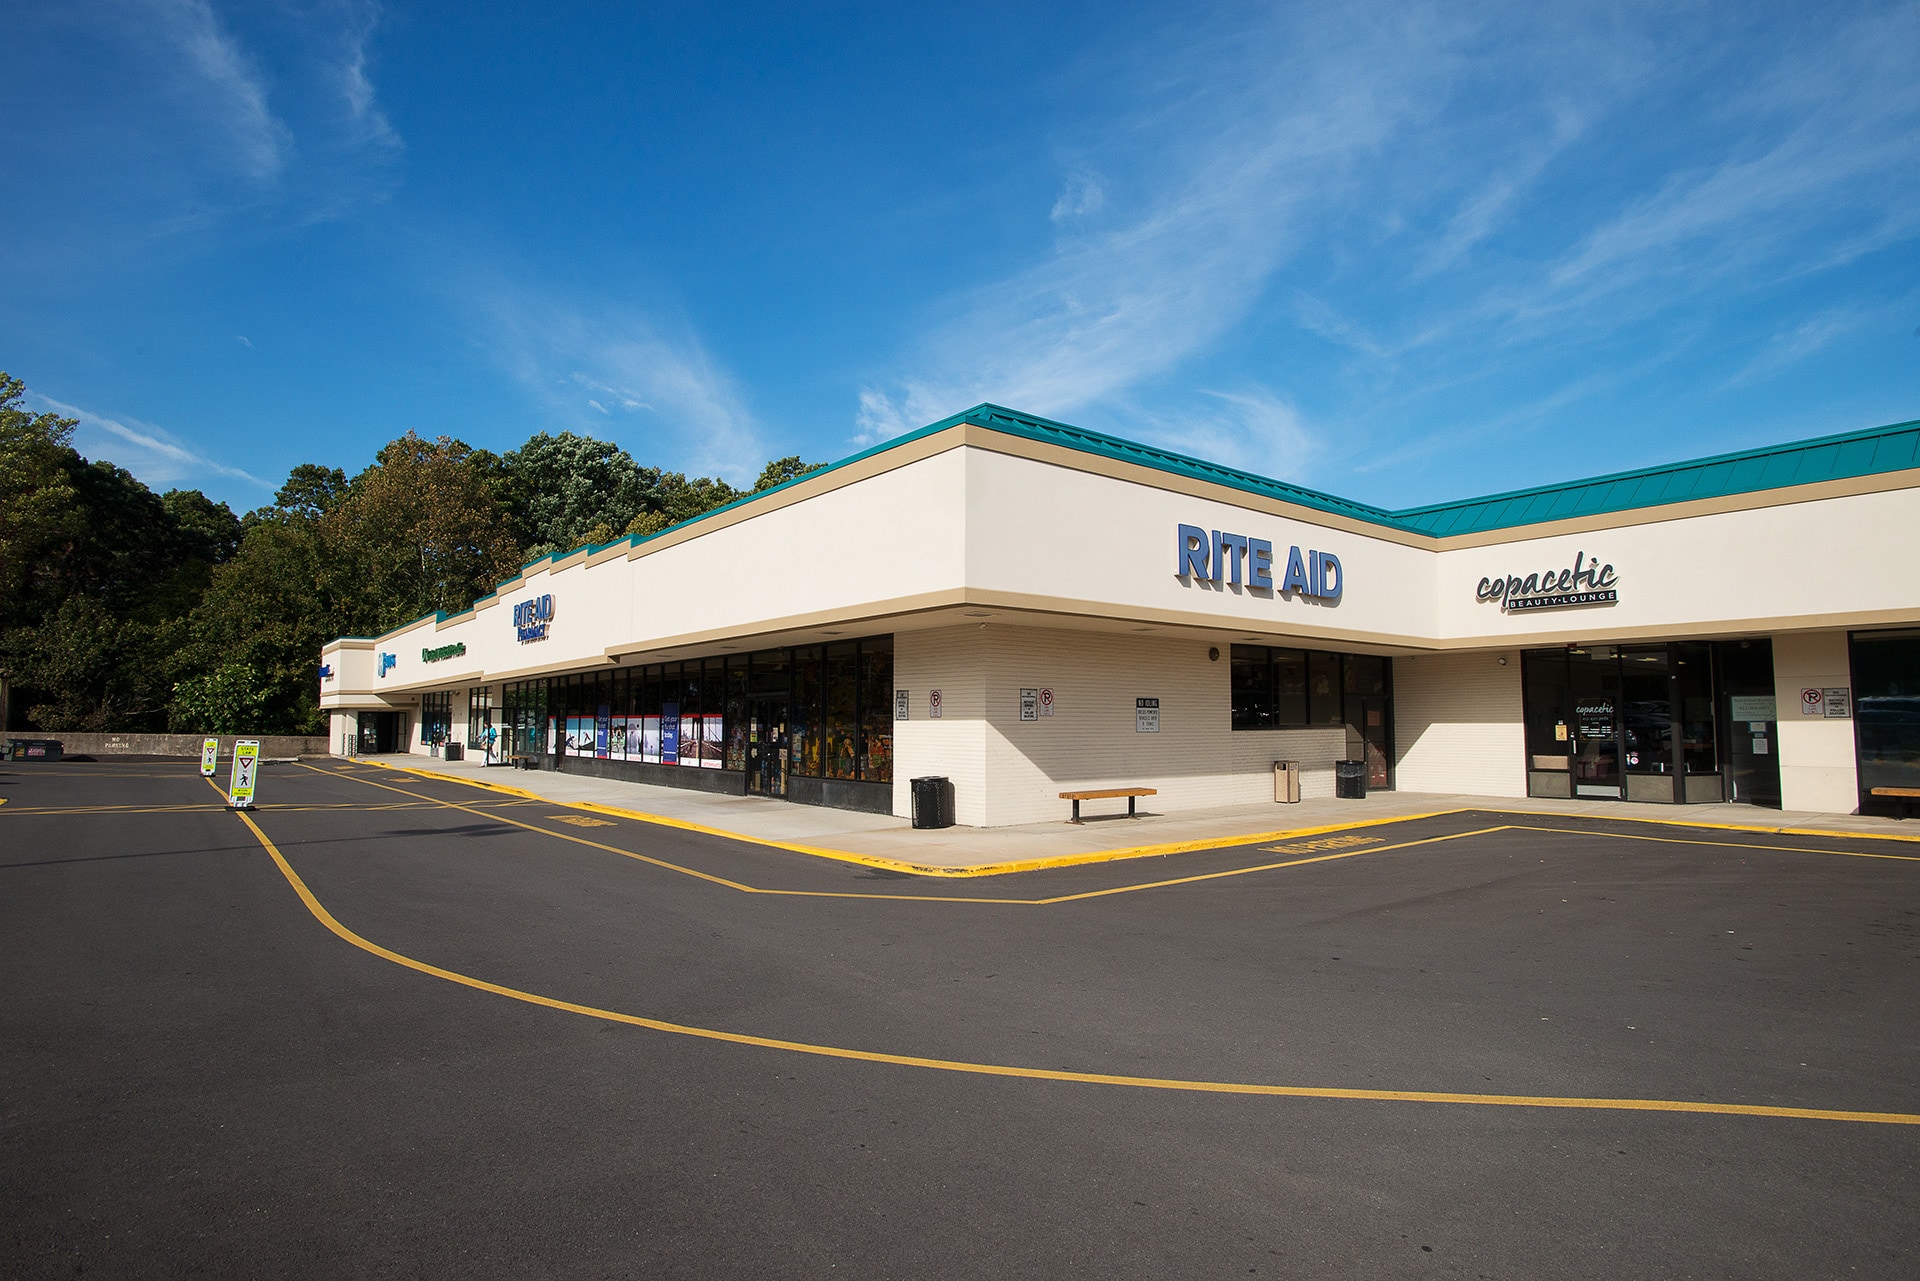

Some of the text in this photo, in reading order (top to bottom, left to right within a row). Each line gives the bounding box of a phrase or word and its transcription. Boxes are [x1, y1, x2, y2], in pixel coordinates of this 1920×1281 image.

[1178, 523, 1343, 598] RITE AID
[1477, 551, 1618, 608] copacetic
[513, 594, 552, 627] RITE AID
[1576, 702, 1614, 716] copacetic
